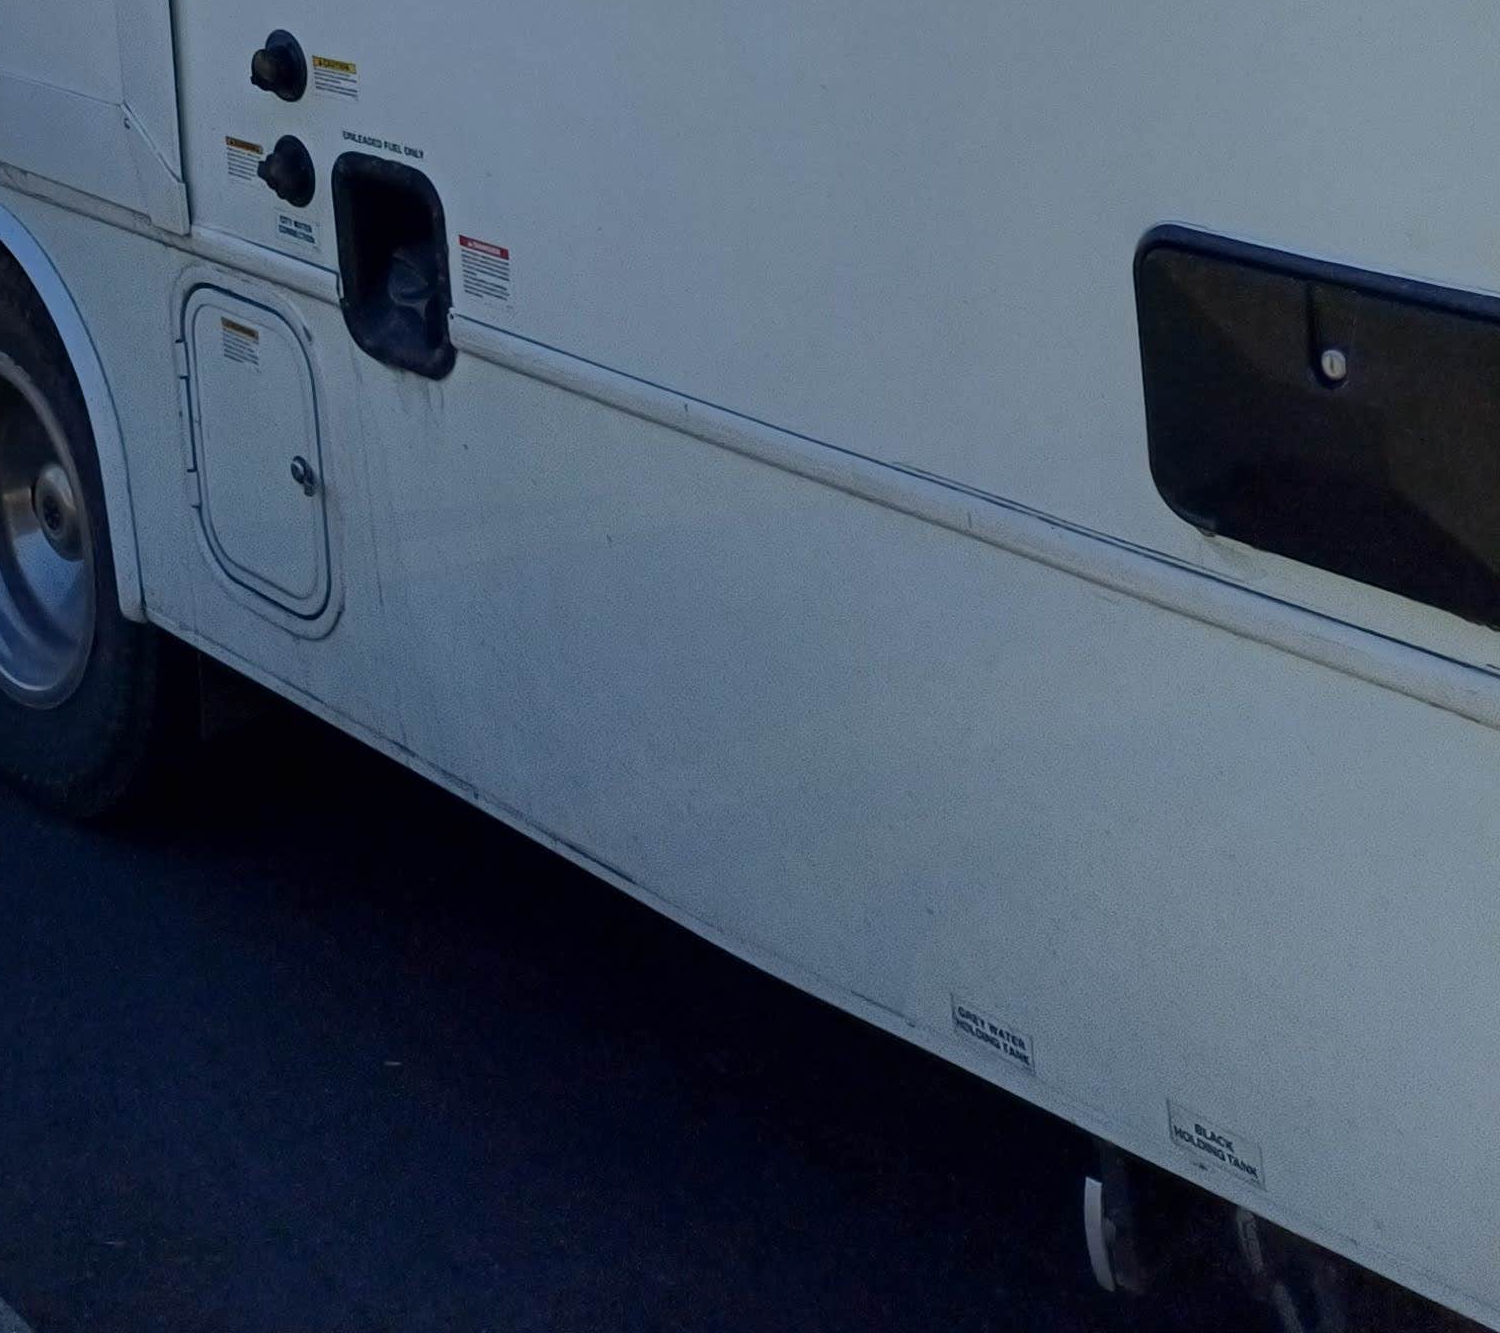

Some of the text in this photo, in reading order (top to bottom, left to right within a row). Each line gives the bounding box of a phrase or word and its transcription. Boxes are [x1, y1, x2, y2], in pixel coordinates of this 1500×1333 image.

[384, 141, 402, 155] FUEL
[956, 1019, 1030, 1066] HOLDING TANK
[988, 1022, 1026, 1051] WATER
[1173, 1125, 1259, 1179] HOLDING TANK
[1194, 1123, 1234, 1153] BLACK
